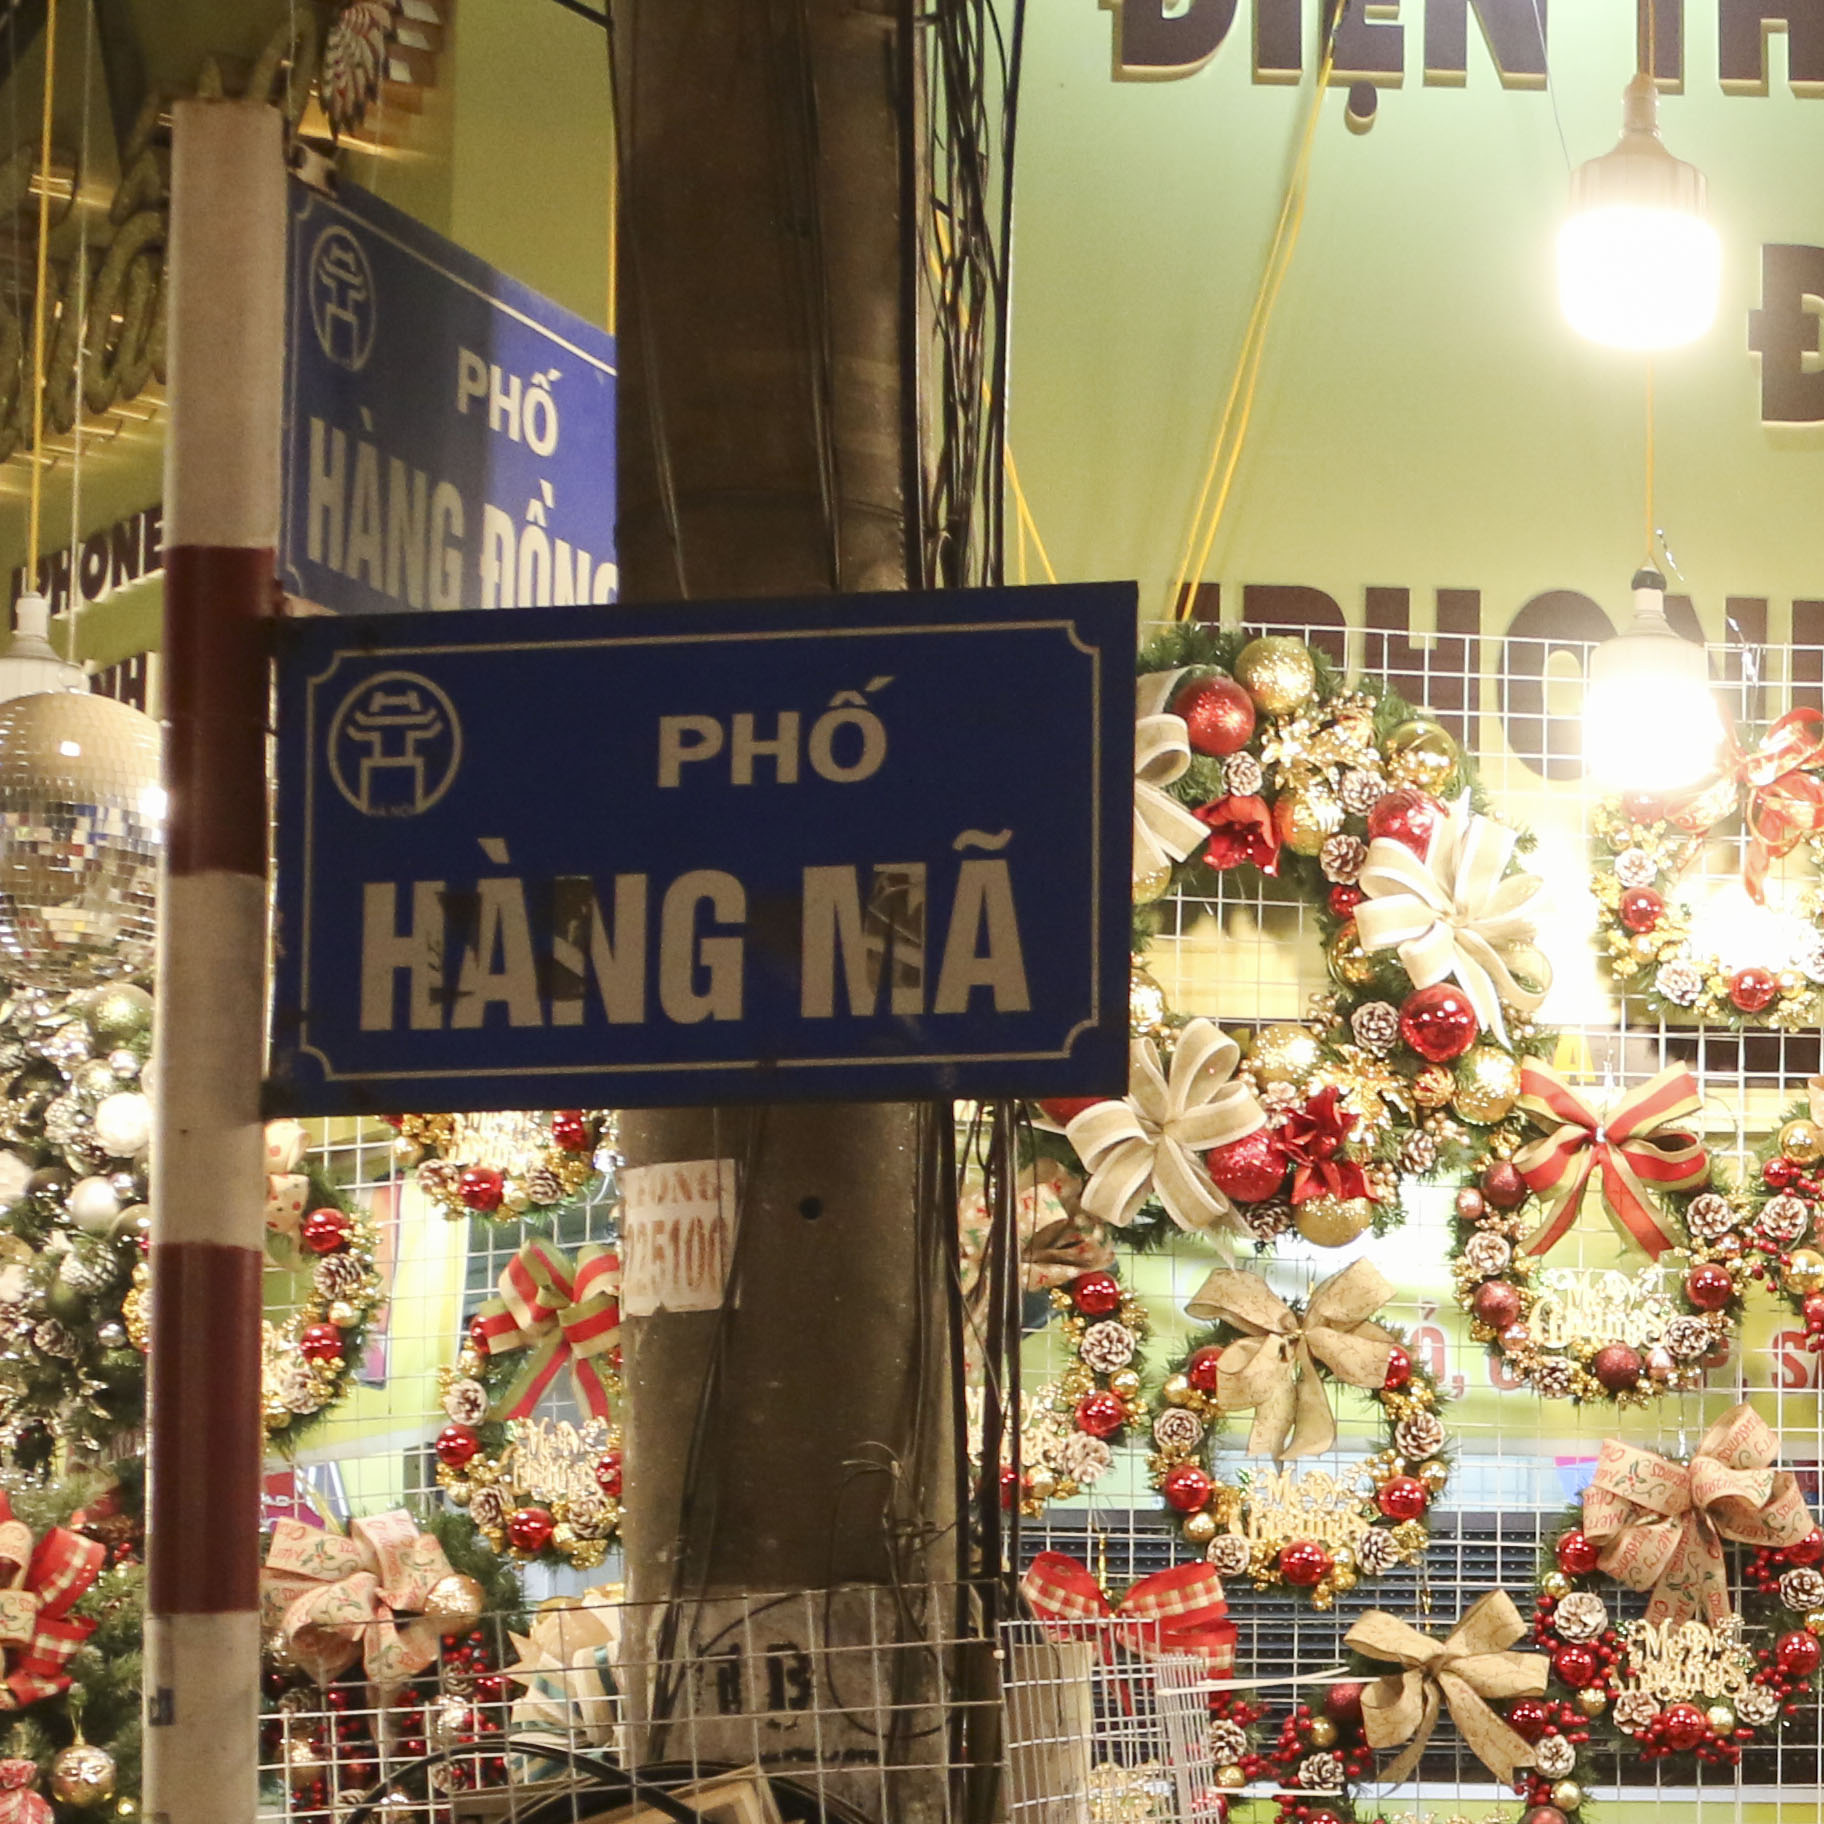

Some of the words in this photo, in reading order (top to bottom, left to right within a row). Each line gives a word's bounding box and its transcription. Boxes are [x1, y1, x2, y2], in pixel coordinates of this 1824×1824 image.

[458, 345, 562, 457] PHỐ
[308, 405, 465, 611] HÀNG
[656, 675, 898, 788] PHỐ
[359, 837, 748, 1031] HÀNG
[799, 827, 1032, 1018] MÃ
